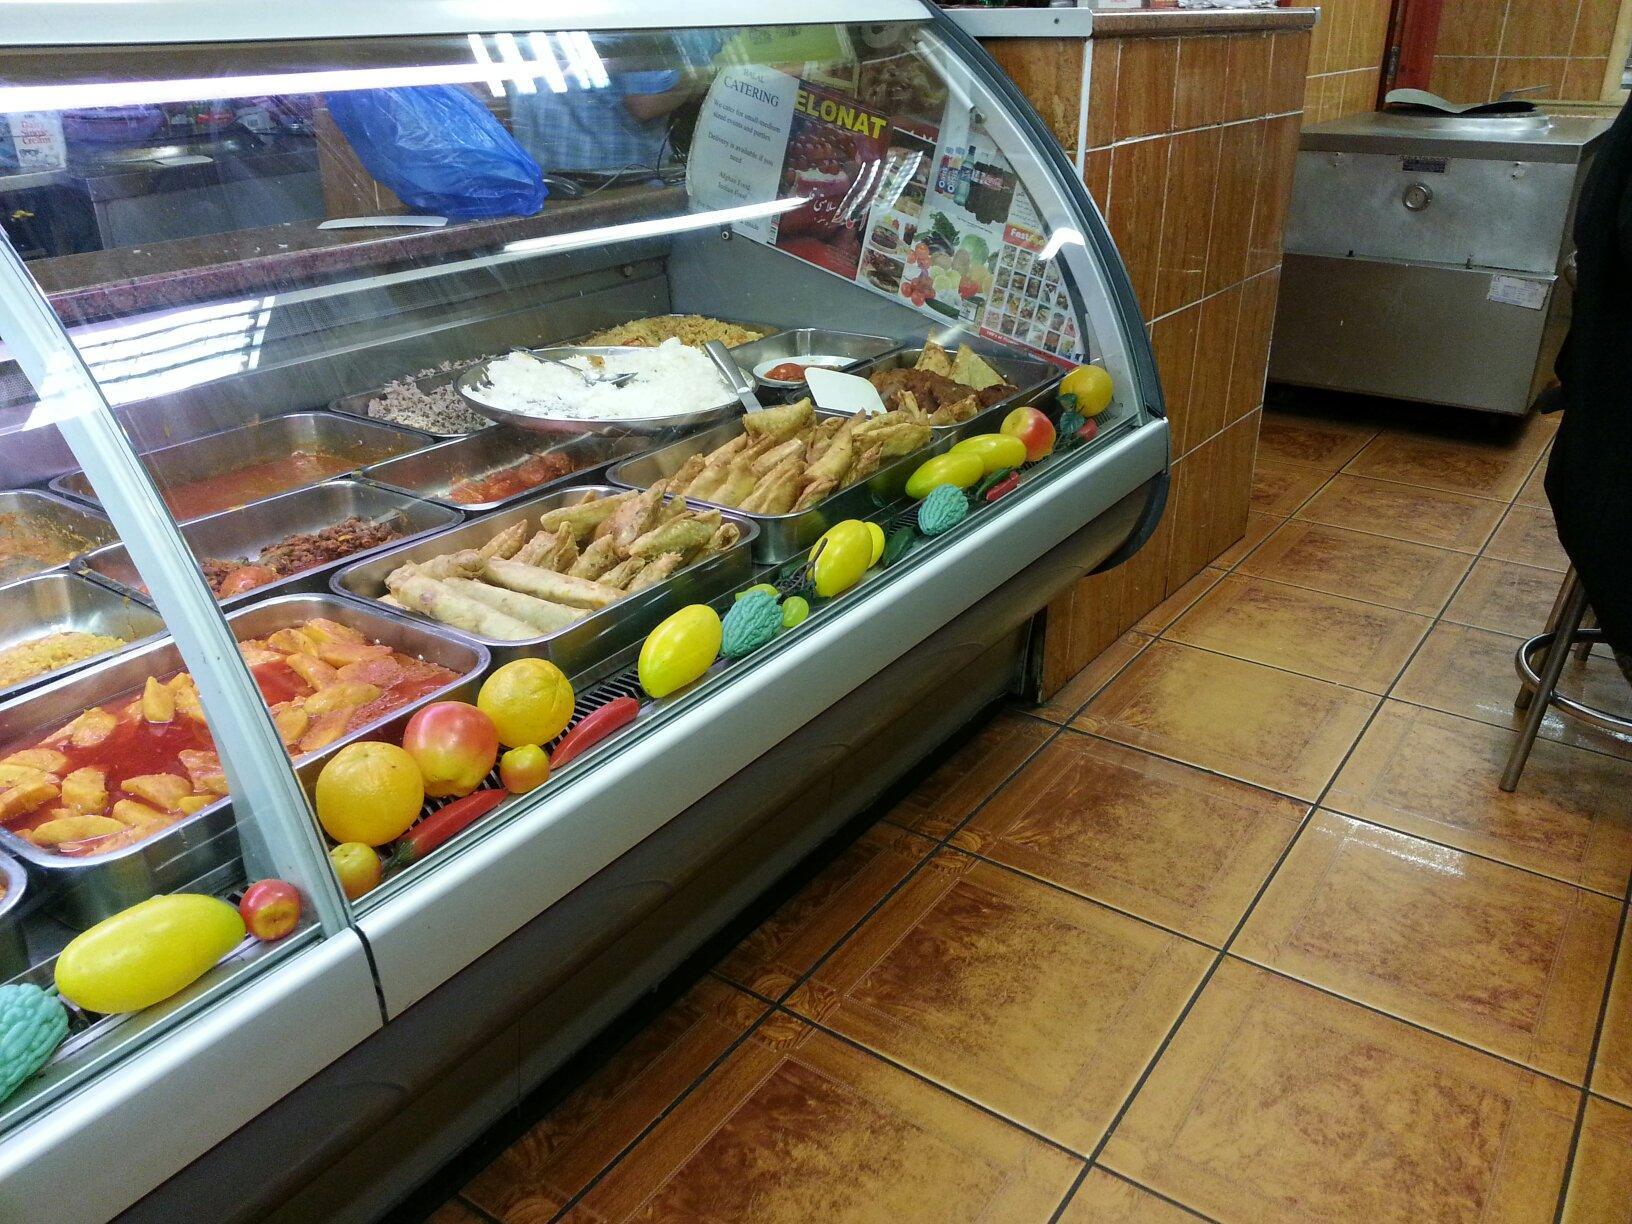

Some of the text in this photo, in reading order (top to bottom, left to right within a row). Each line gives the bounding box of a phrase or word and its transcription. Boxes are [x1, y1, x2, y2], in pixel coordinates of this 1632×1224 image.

[723, 75, 780, 107] CATERING
[726, 118, 743, 129] events
[708, 131, 729, 147] Delivery
[735, 145, 758, 159] available
